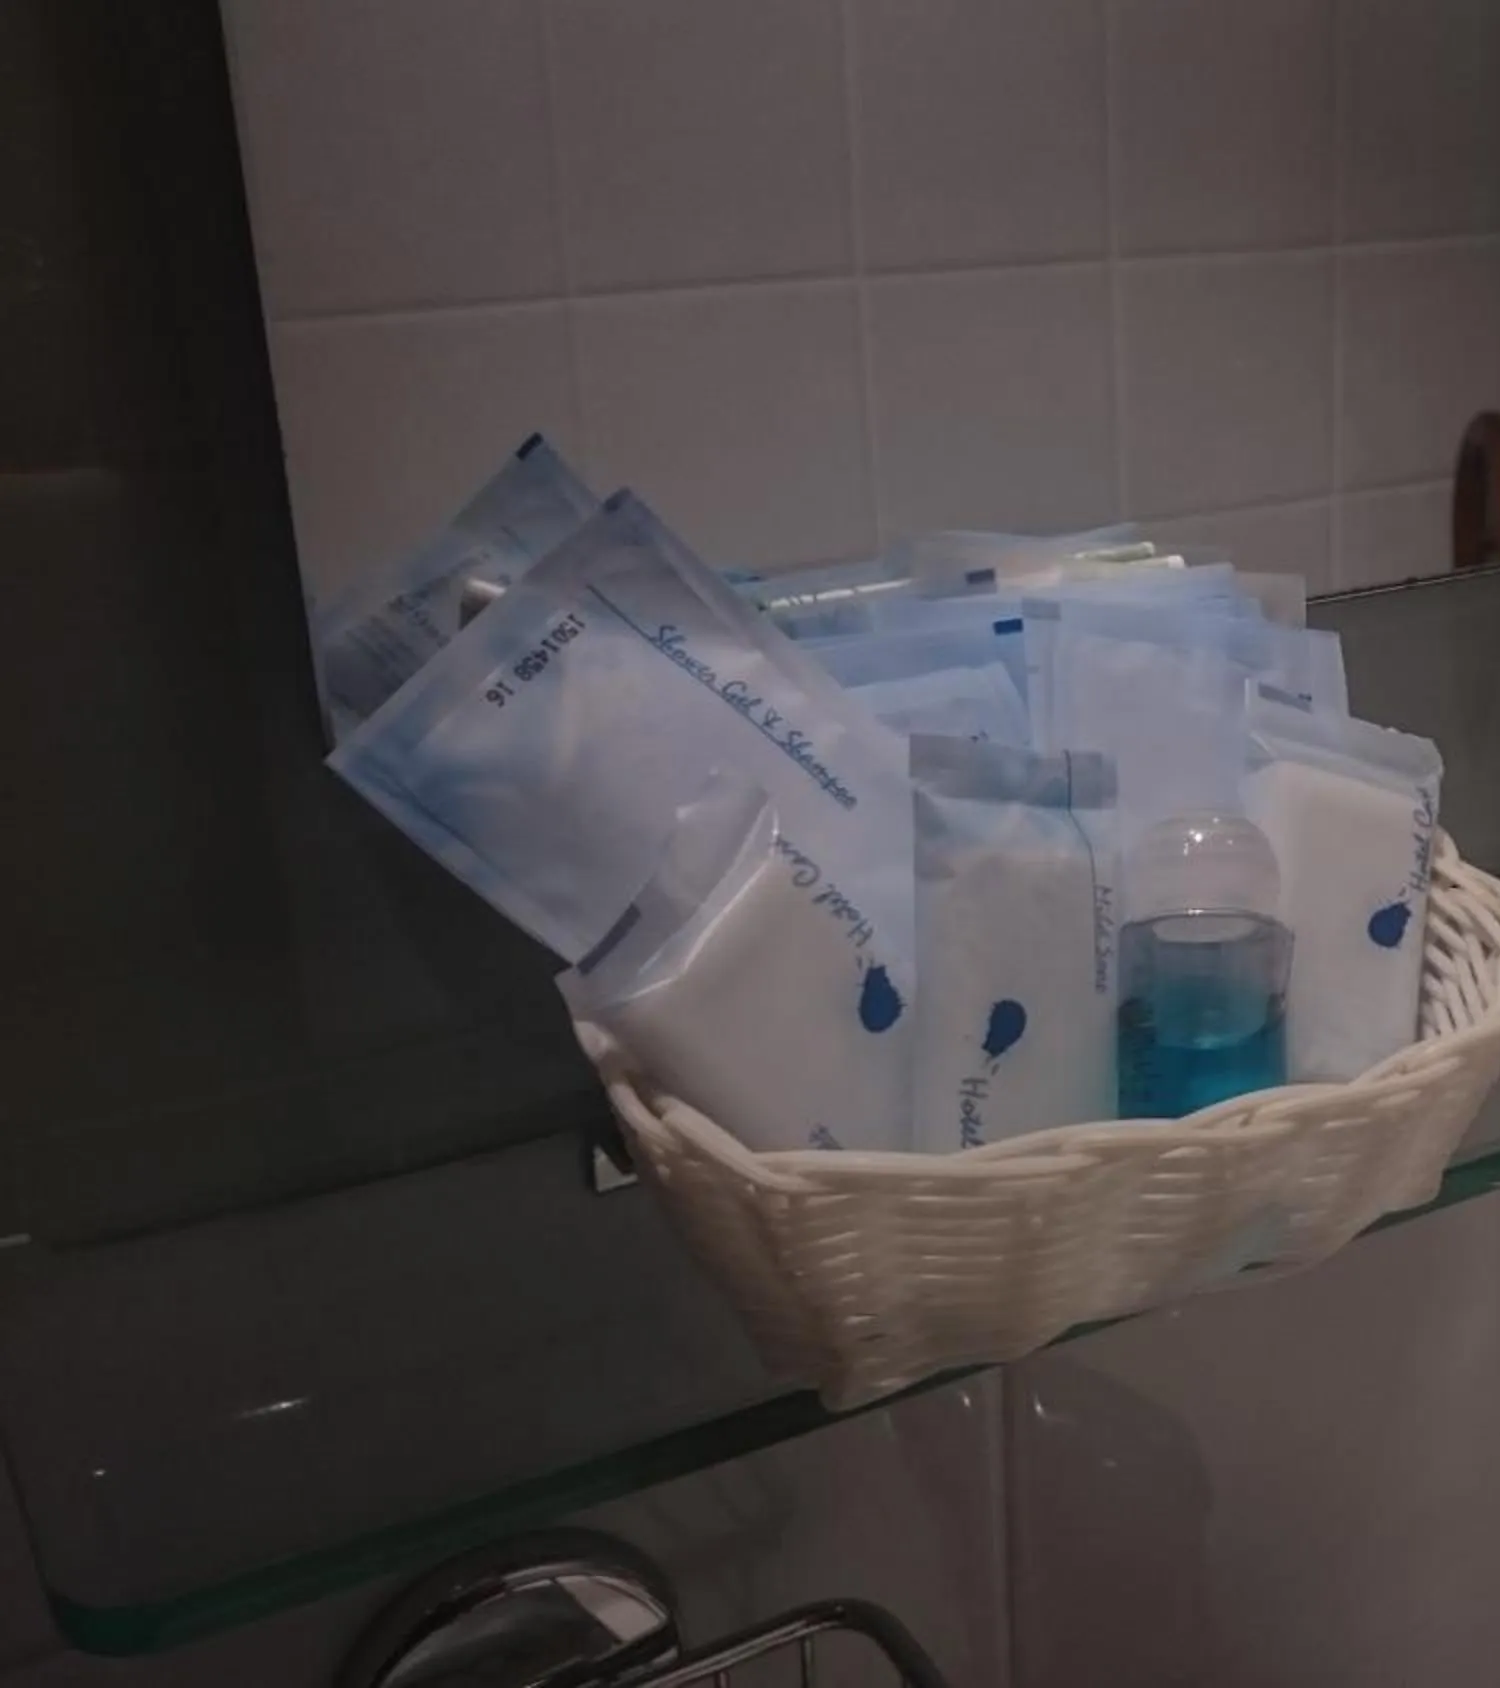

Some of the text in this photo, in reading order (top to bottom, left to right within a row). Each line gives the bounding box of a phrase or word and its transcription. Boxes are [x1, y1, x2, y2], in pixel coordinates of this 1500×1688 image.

[485, 680, 515, 708] 16
[812, 882, 874, 948] Hotel
[959, 1077, 989, 1149] Hotel
